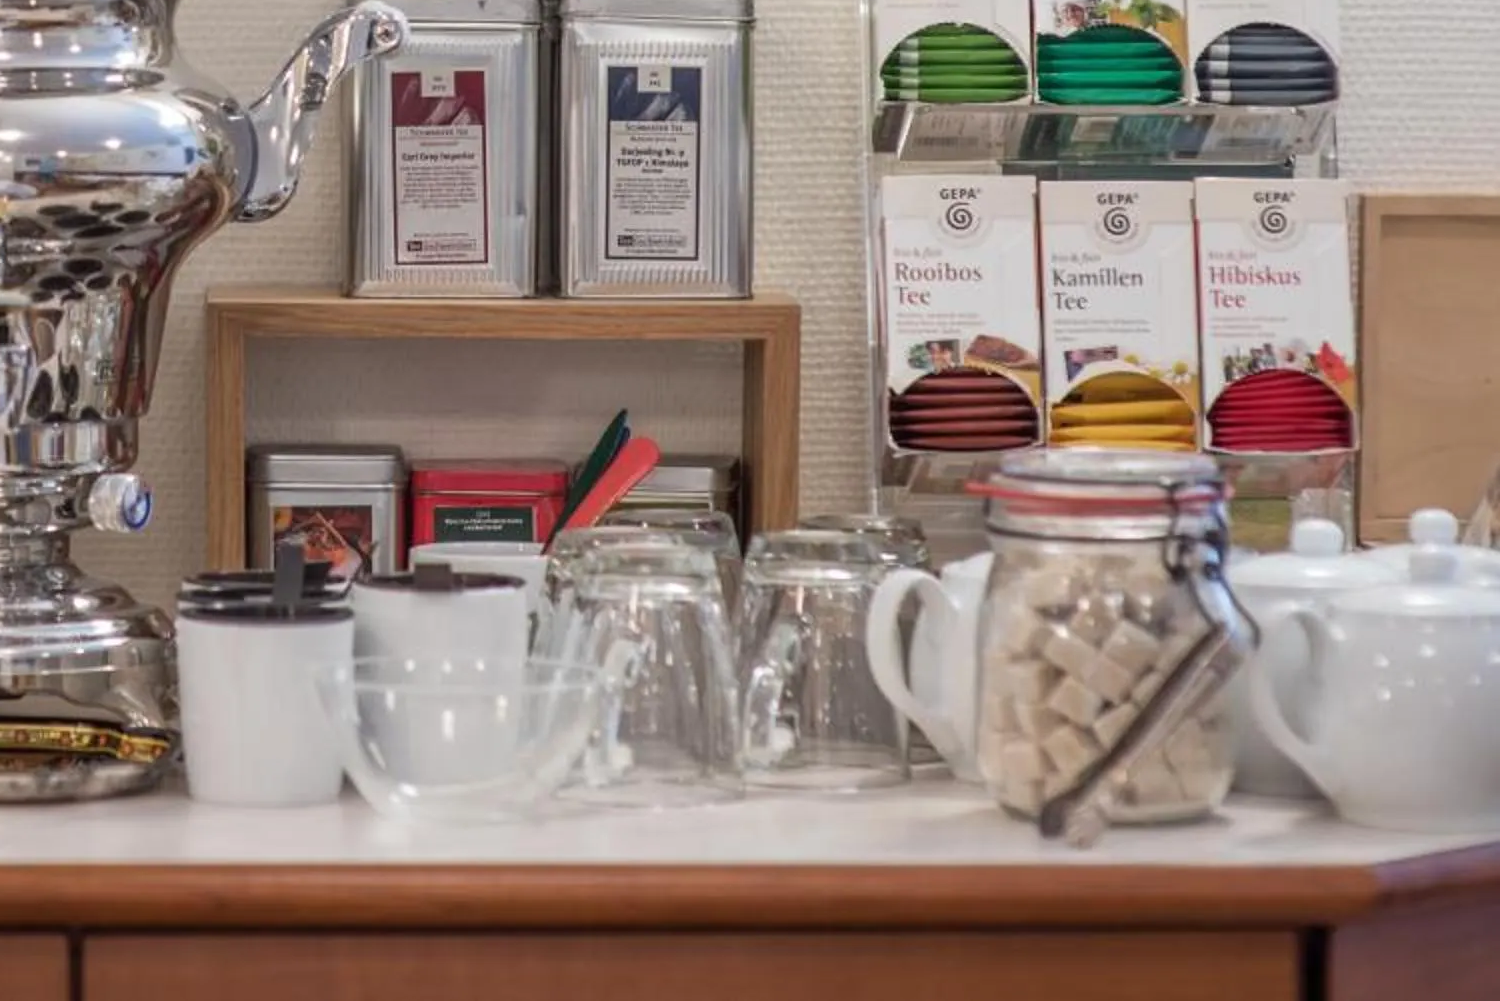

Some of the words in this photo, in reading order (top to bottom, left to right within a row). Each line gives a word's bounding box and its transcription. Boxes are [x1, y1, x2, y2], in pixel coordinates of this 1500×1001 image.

[894, 261, 983, 282] Rooibos
[1052, 267, 1144, 287] Kamillen
[1208, 265, 1302, 286] Hibiskus
[893, 285, 931, 305] Tee
[1053, 291, 1089, 311] Tee
[1209, 289, 1246, 309] Tee
